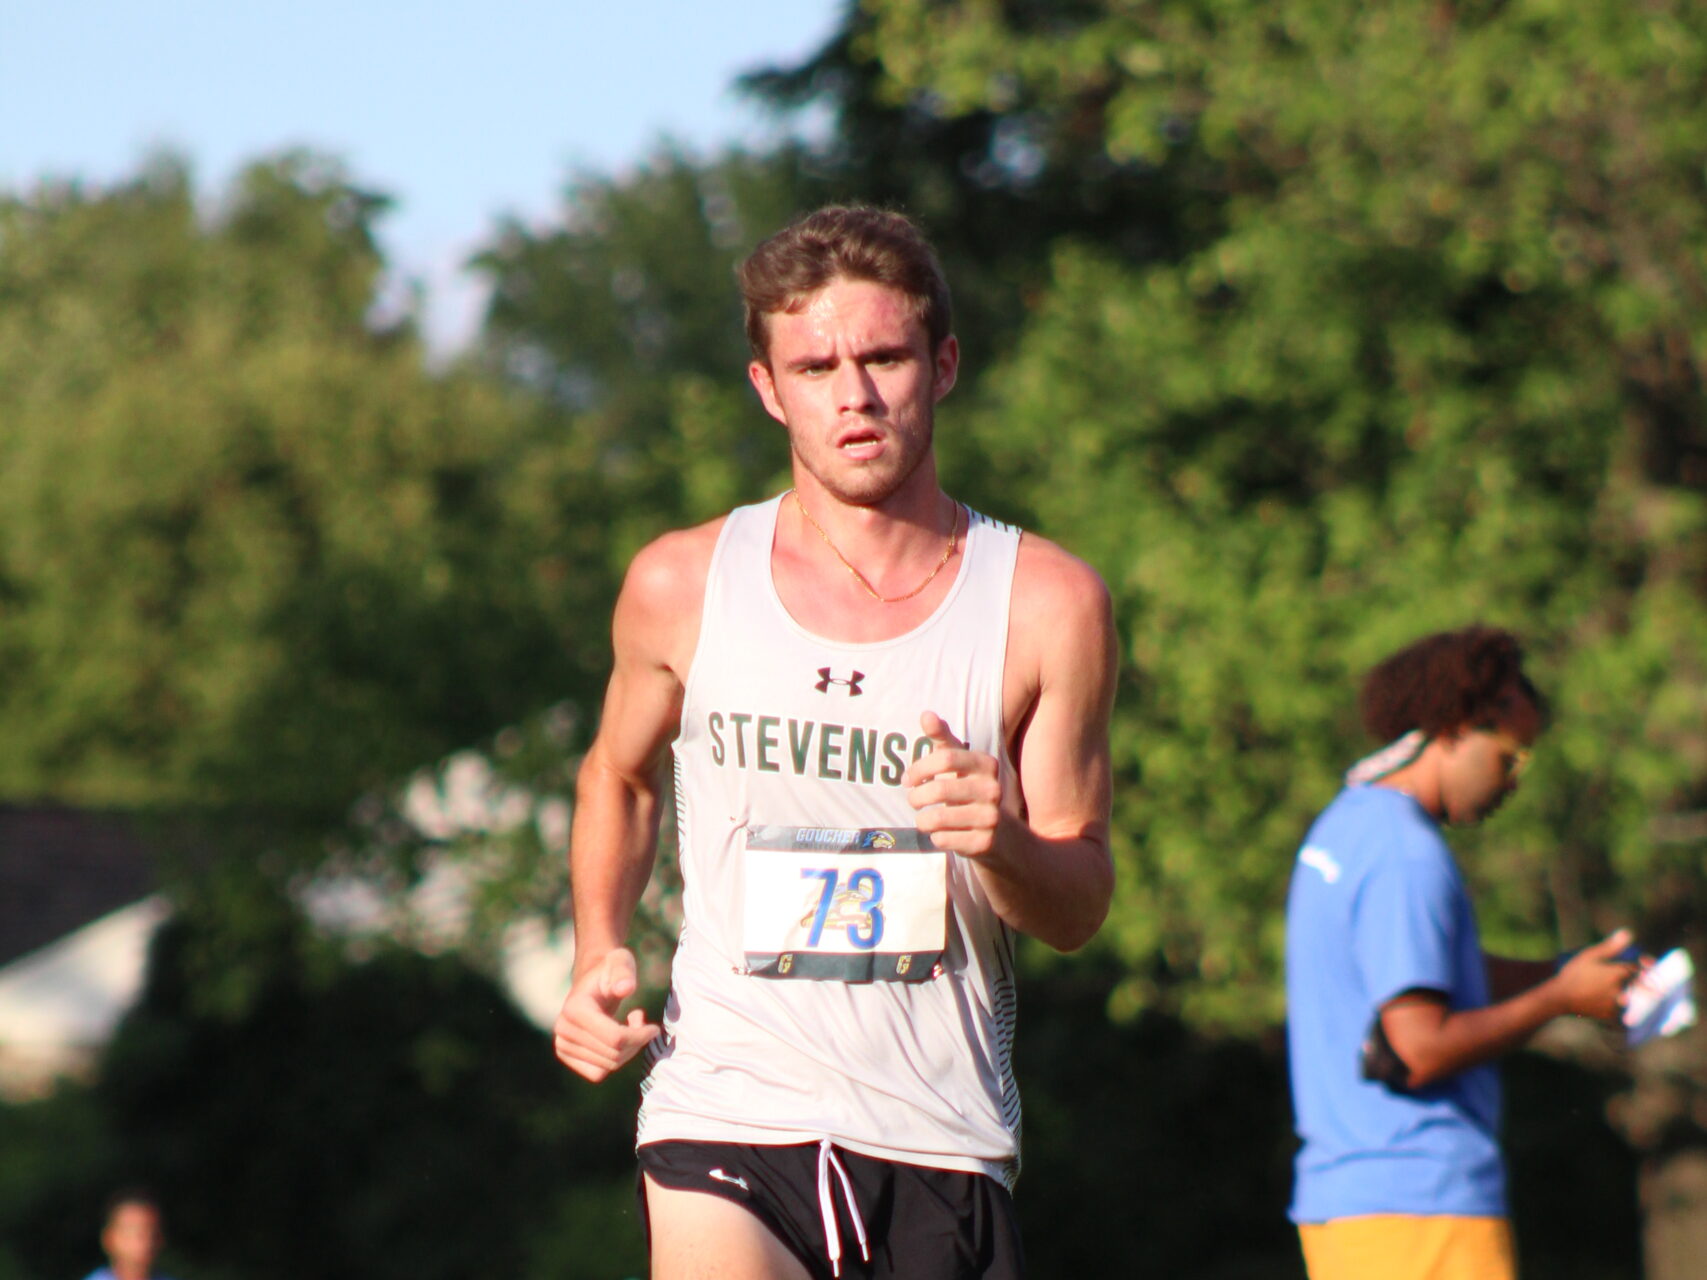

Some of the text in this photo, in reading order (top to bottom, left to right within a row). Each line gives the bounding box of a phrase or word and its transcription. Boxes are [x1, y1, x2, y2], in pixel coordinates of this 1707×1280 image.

[708, 711, 970, 787] STEVENS
[796, 828, 860, 844] GOUCHER
[801, 867, 885, 949] 73
